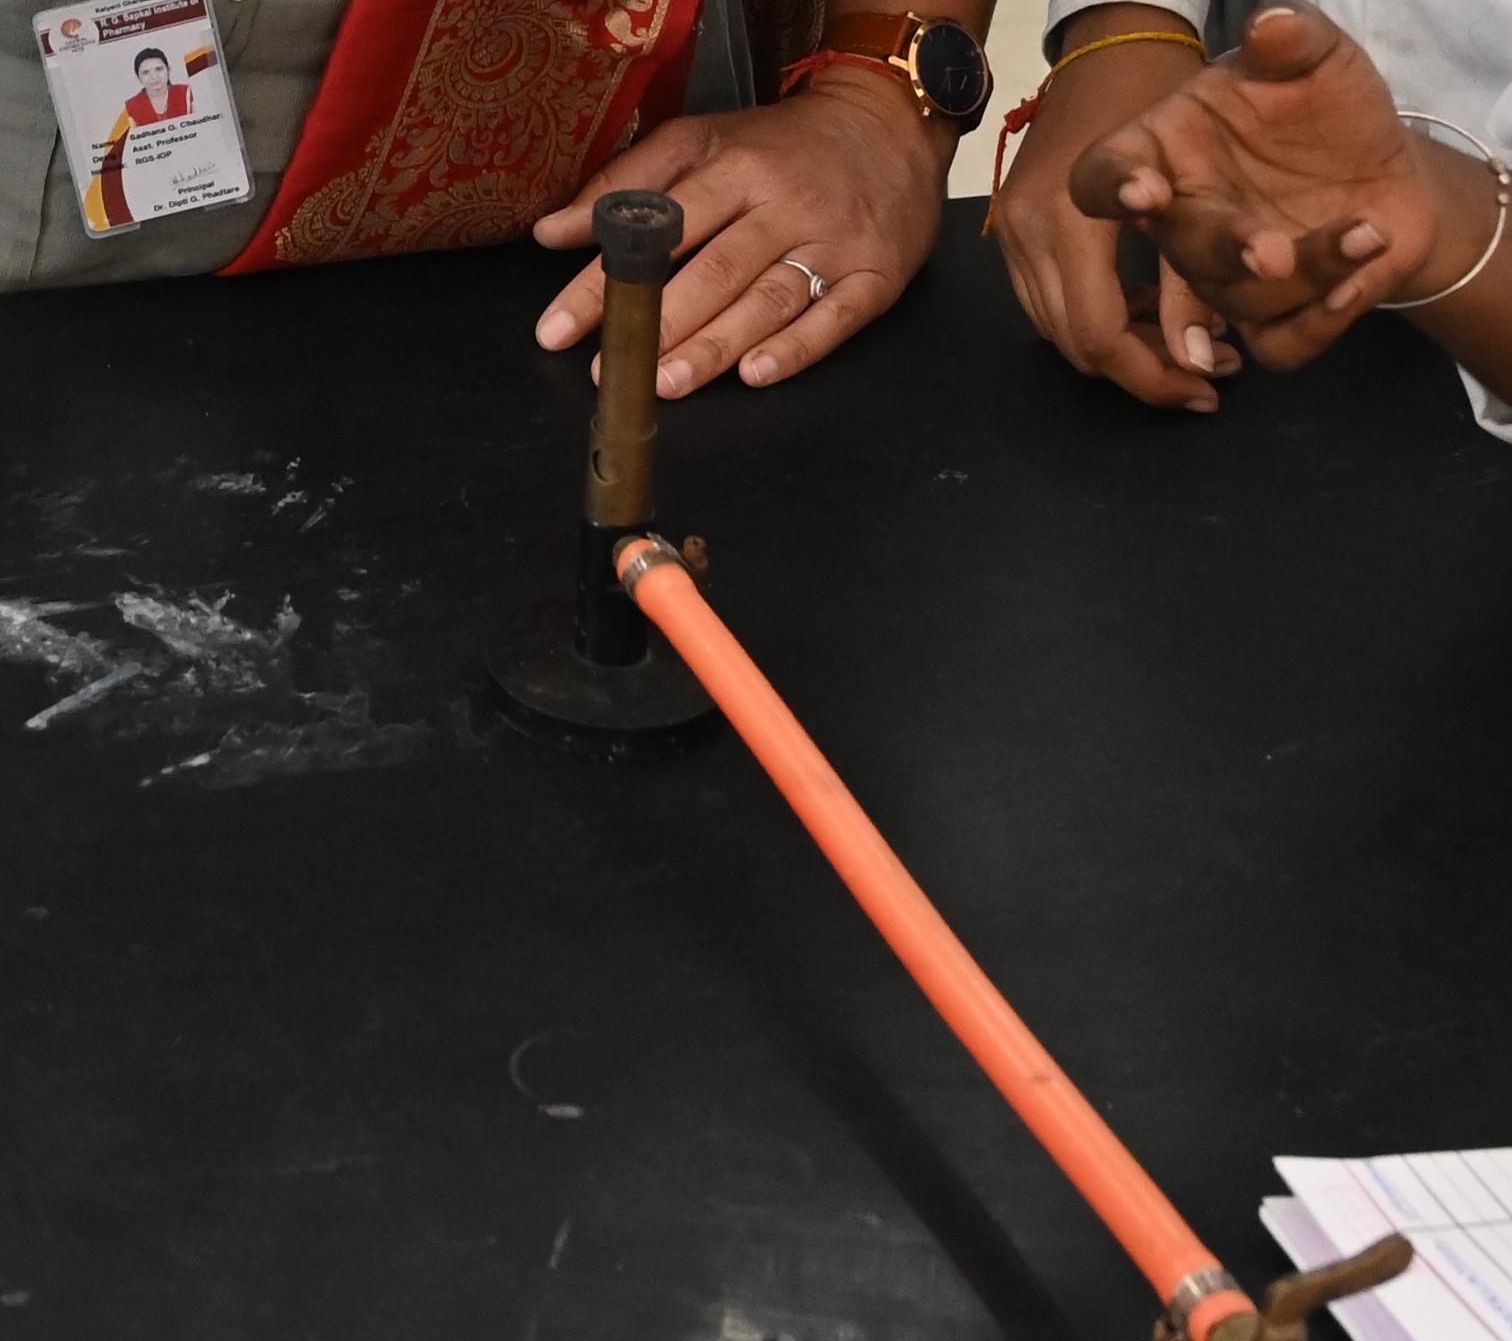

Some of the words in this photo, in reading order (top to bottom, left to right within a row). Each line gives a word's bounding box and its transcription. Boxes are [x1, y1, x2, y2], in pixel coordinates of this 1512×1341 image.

[153, 0, 189, 15] Institute
[102, 21, 146, 38] Pharmacy
[167, 123, 178, 132] G.
[132, 143, 154, 154] Asst.
[156, 132, 198, 148] Professor
[177, 180, 215, 195] Principal
[153, 203, 167, 212] Dr.
